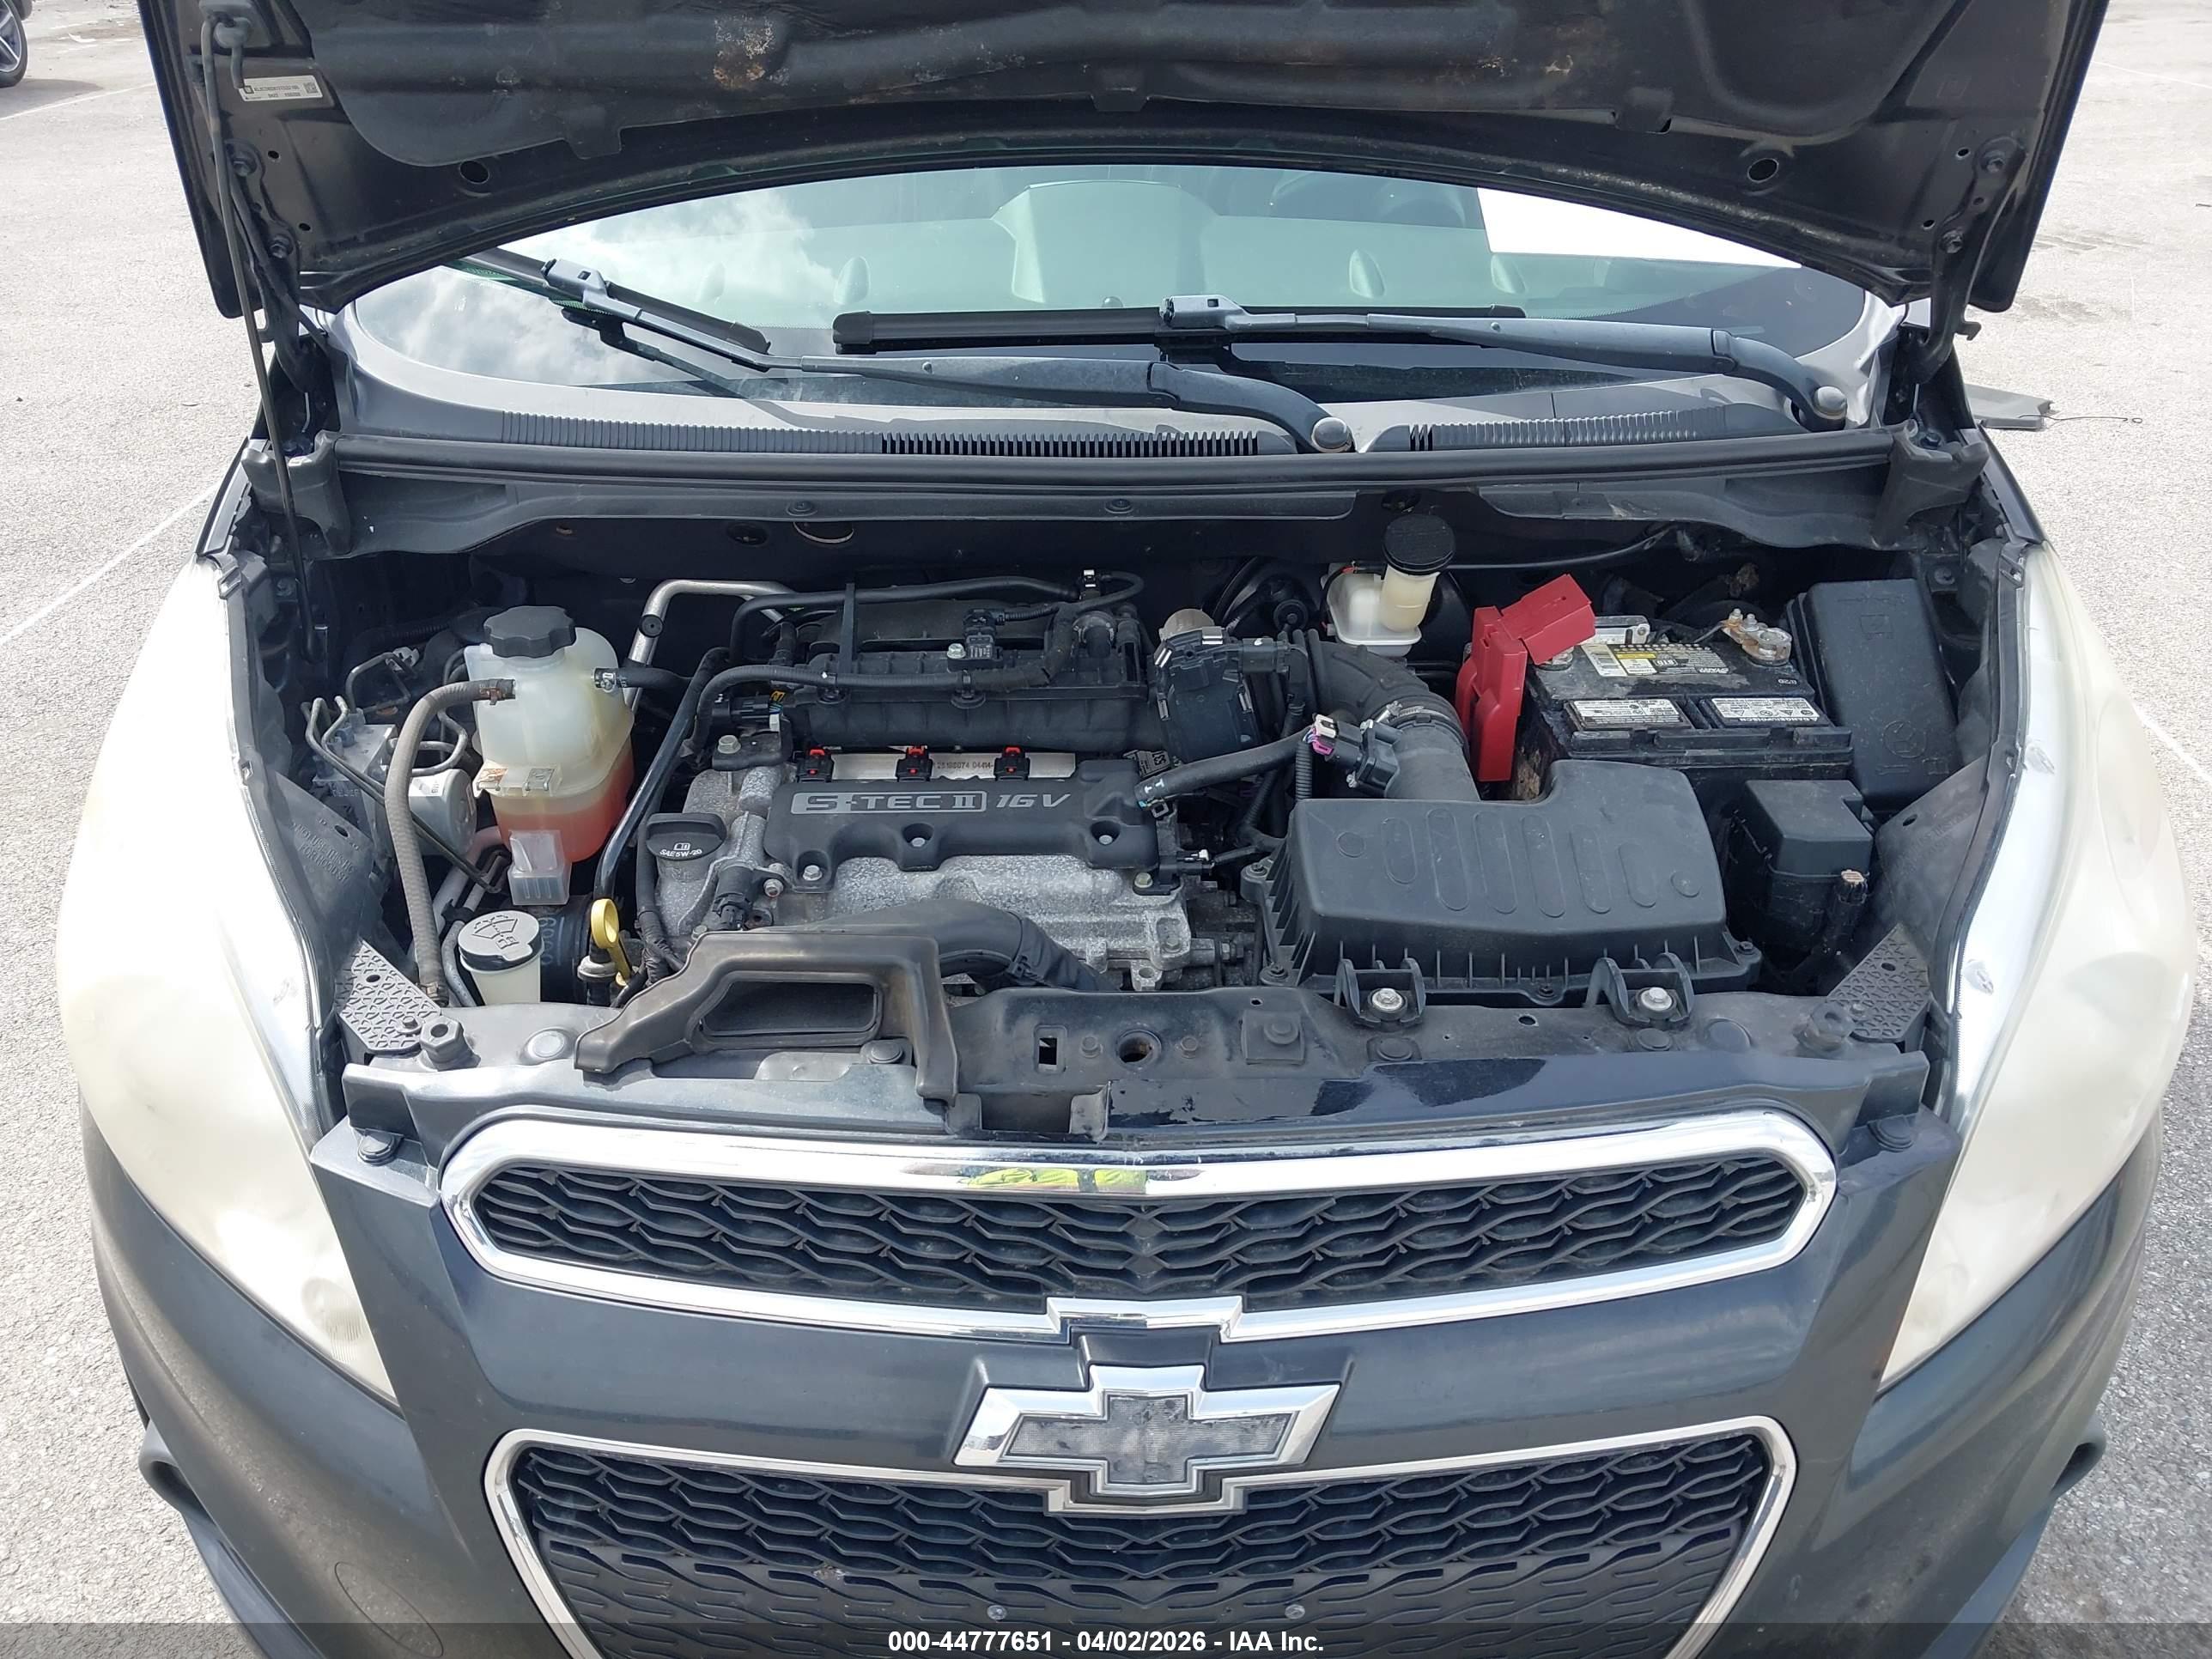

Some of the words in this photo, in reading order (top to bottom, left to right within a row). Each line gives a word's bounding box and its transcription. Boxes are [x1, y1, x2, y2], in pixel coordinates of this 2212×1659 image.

[805, 794, 942, 811] S-TEC
[996, 793, 1072, 809] 16V
[659, 848, 676, 857] SAE
[675, 848, 702, 857] 5W-20
